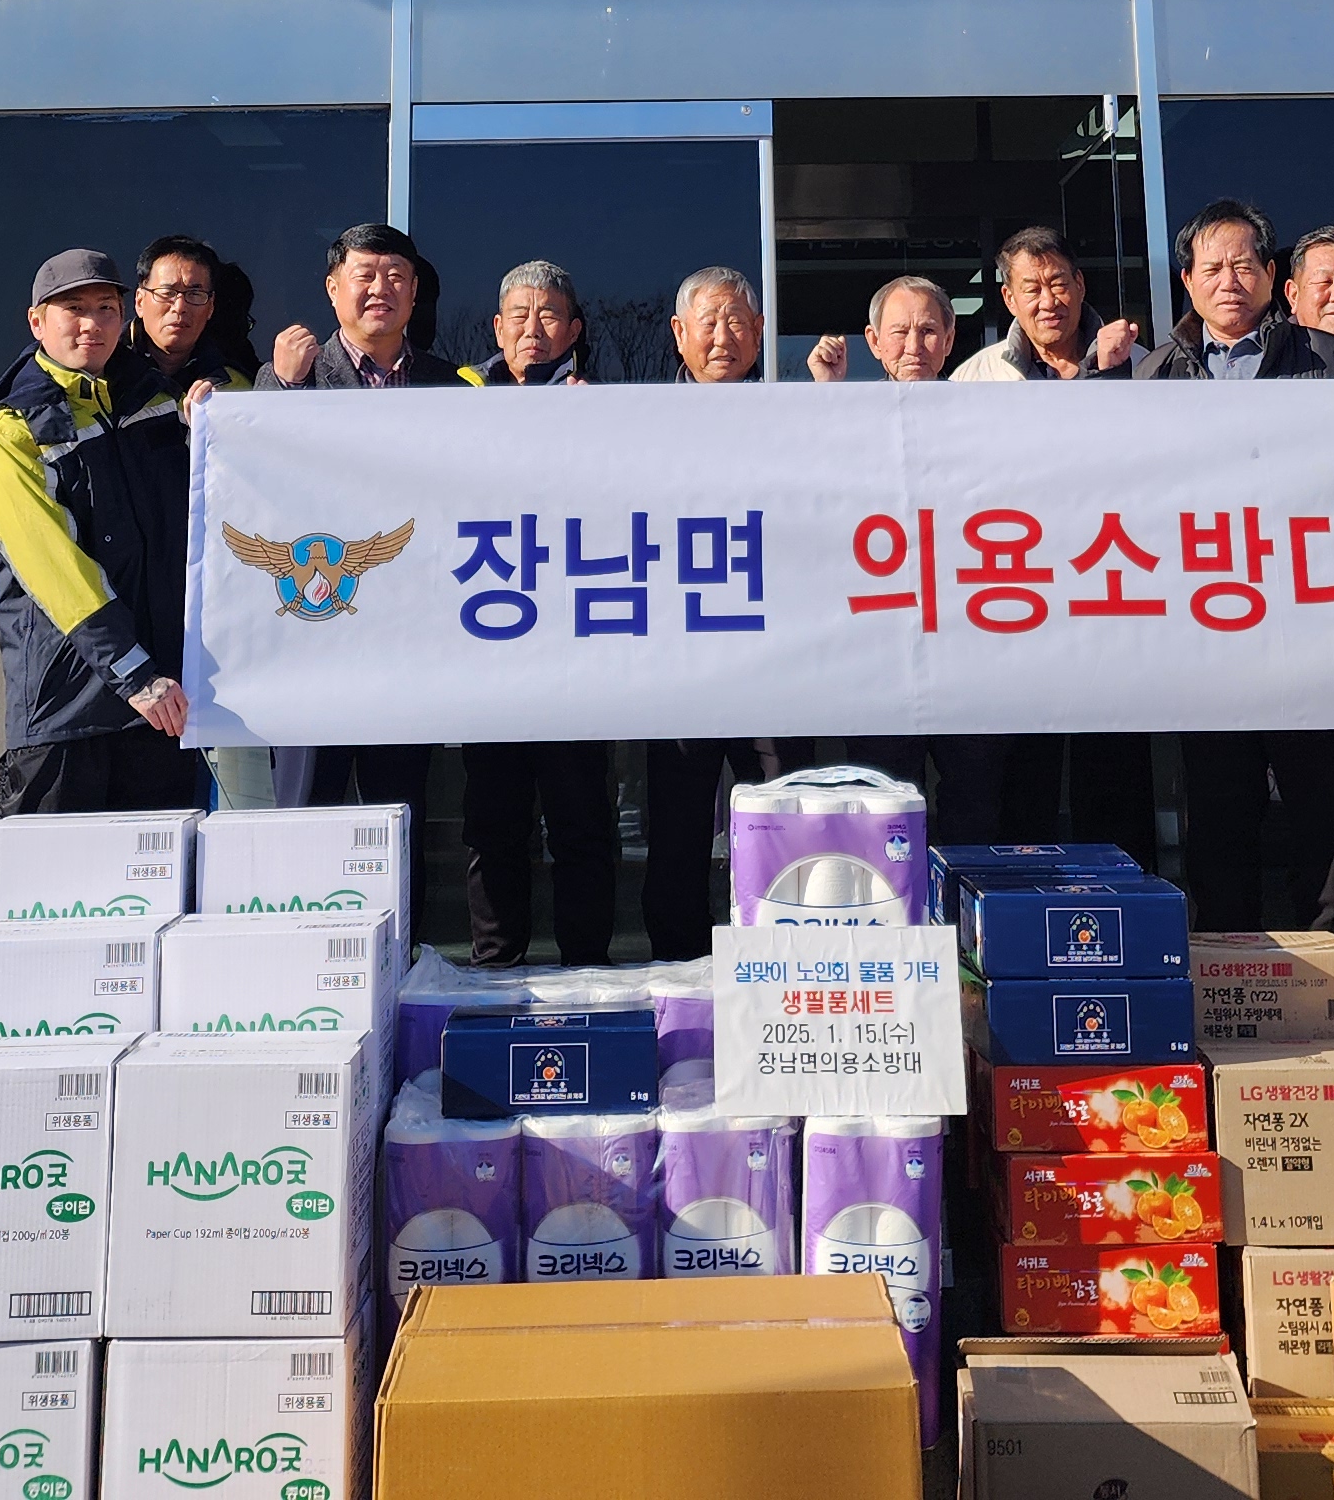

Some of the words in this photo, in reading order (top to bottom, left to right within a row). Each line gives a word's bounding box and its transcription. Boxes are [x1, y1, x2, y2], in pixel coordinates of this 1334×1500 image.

[451, 509, 769, 641] 장남면
[132, 866, 167, 877] 위생용품
[348, 861, 384, 873] 위생용품
[1163, 954, 1169, 963] 5
[1170, 954, 1181, 964] kg
[733, 961, 787, 983] 설맞이
[796, 961, 850, 983] 노인회
[858, 961, 895, 983] 물품
[903, 961, 940, 983] 기탁
[99, 979, 138, 993] 위생용품
[322, 975, 360, 987] 위생용품
[781, 990, 895, 1015] 생필품세트
[1202, 987, 1246, 1005] 자연퐁
[1250, 991, 1278, 1004] (Y22)
[1244, 1008, 1282, 1021] 주방세제
[762, 1023, 815, 1044] 2025.
[827, 1023, 842, 1044] 1.
[1203, 1024, 1233, 1038] 레몬향
[1170, 1042, 1176, 1051] 5
[1178, 1041, 1189, 1052] kg
[757, 1051, 922, 1074] 장남면의용소방대
[1009, 1078, 1042, 1090] 서귀포
[630, 1092, 636, 1100] 5
[637, 1091, 649, 1101] kg
[51, 1114, 93, 1127] 위생용품
[291, 1113, 332, 1126] 위생용품
[1243, 1112, 1286, 1132] 자연퐁
[1289, 1113, 1309, 1128] 2X
[1244, 1137, 1277, 1152] 비린내
[1279, 1137, 1322, 1152] 걱정없는
[1246, 1157, 1279, 1171] 오렌지
[1023, 1170, 1056, 1182] 서귀포
[50, 1200, 91, 1216] 종이컵
[290, 1198, 330, 1213] 종이컵
[1250, 1216, 1268, 1229] 1.4
[1270, 1216, 1277, 1229] L
[1289, 1215, 1324, 1230] 10개입
[146, 1228, 171, 1240] Paper
[173, 1228, 192, 1240] Cup
[195, 1227, 224, 1239] 192ml
[225, 1227, 251, 1240] 종이컵
[536, 1252, 628, 1276] 크리넥스
[673, 1248, 763, 1271] 크리넥스
[828, 1252, 919, 1276] 크리넥스
[1016, 1257, 1049, 1269] 서귀포
[398, 1258, 489, 1282] 크리넥스
[1276, 1297, 1324, 1316] 자연퐁
[1278, 1321, 1320, 1336] 스팀워시
[1278, 1340, 1311, 1355] 레몬향
[28, 1392, 70, 1408] 위생용품
[284, 1396, 326, 1410] 위생용품
[987, 1440, 1023, 1456] 9501
[27, 1482, 68, 1499] 종이컵
